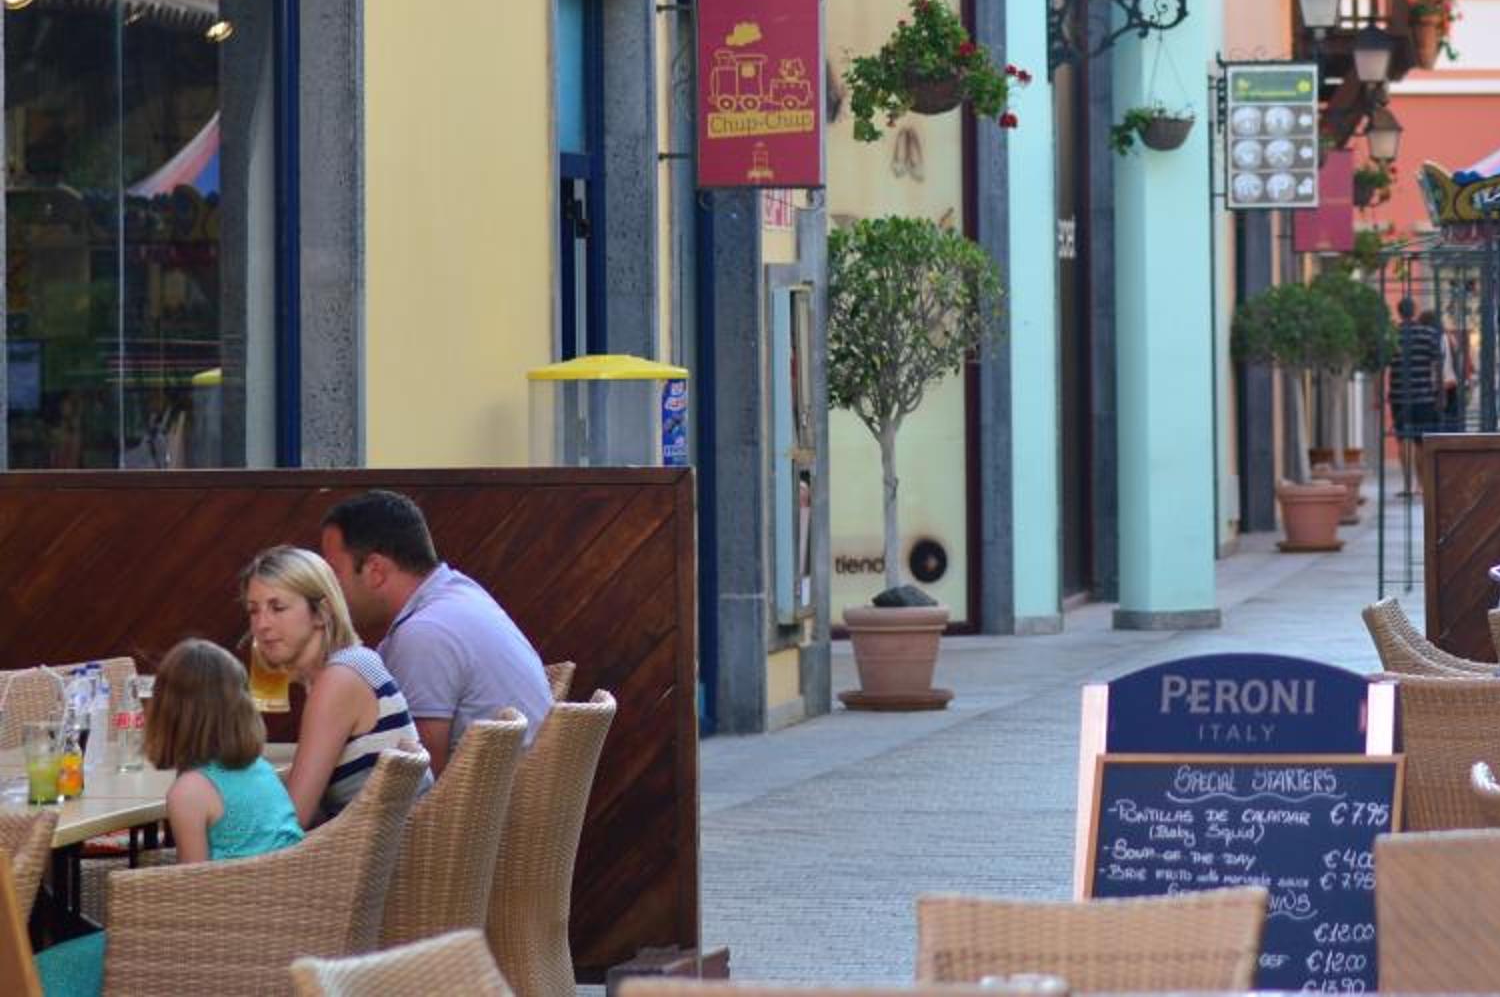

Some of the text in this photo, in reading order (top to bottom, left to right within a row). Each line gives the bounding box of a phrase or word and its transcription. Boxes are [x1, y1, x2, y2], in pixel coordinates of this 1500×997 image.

[835, 555, 886, 574] tiend
[1161, 674, 1316, 714] PERONI
[1199, 724, 1275, 741] ITALY
